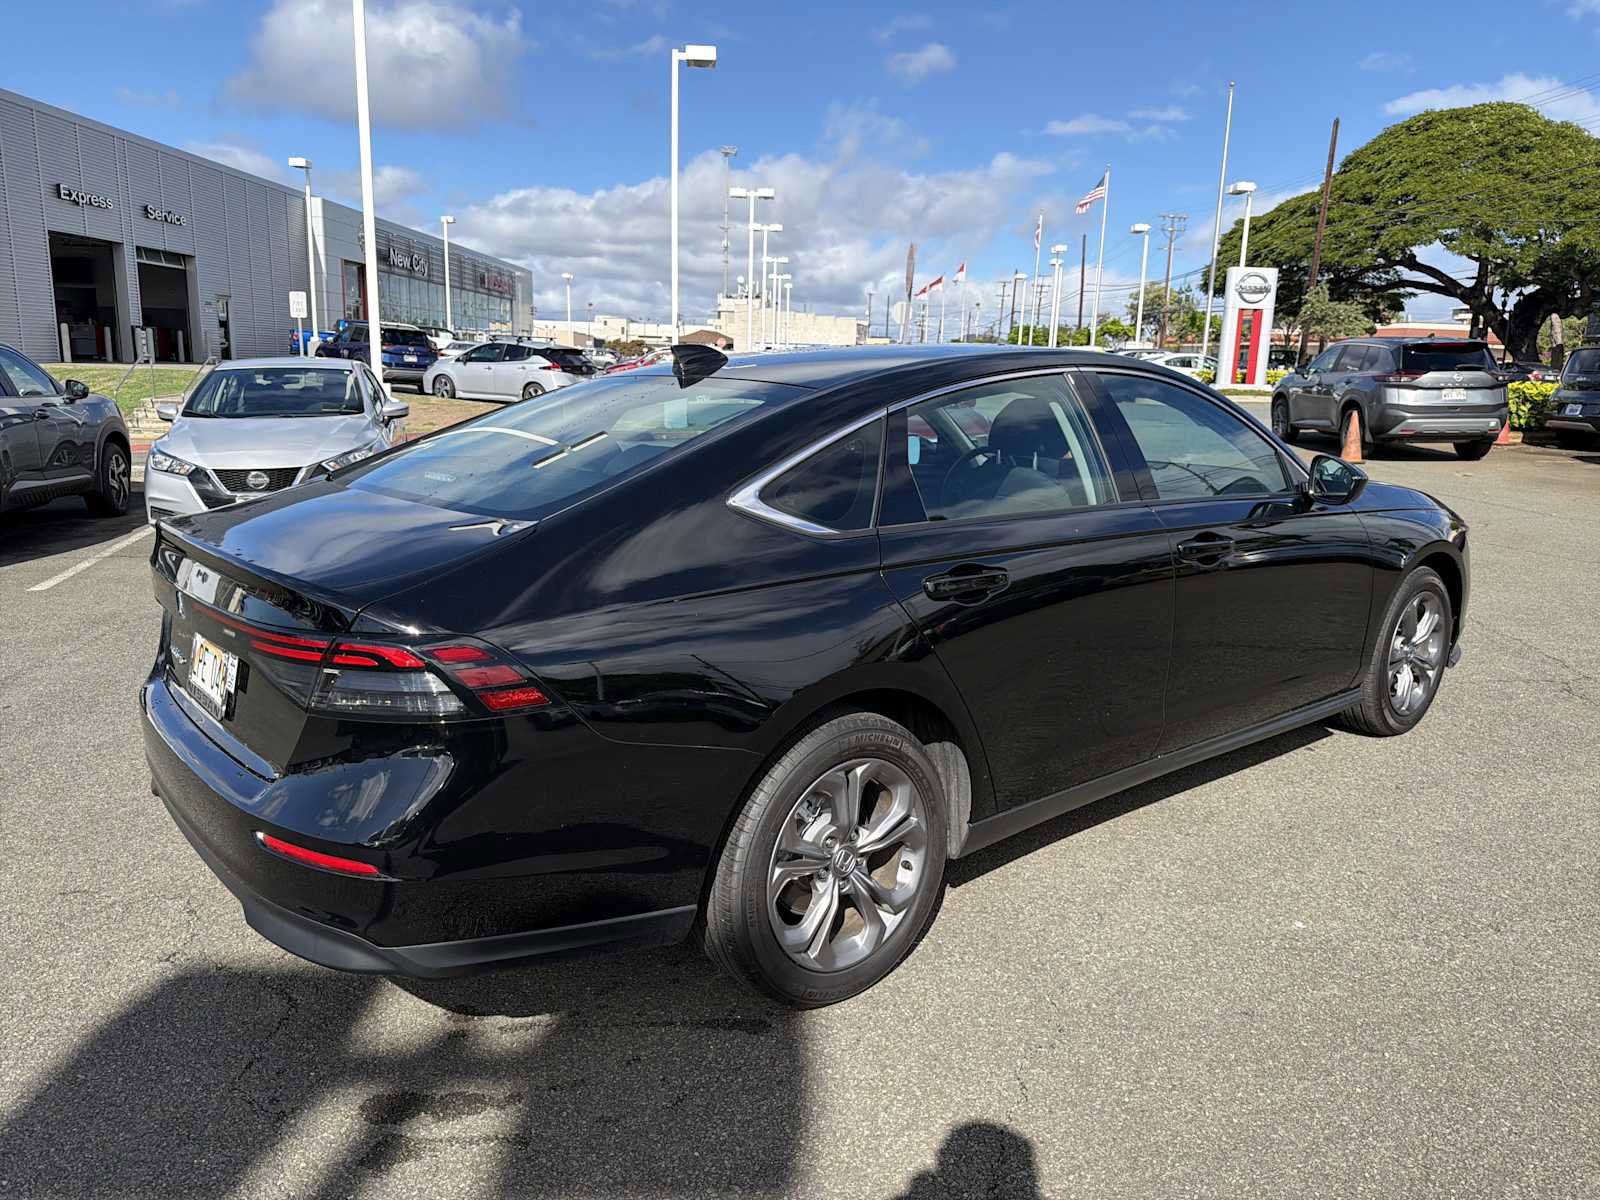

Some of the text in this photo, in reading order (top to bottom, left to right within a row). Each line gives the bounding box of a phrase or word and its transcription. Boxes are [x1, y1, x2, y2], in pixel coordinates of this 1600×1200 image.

[58, 183, 187, 226] Express Service
[389, 247, 429, 277] New City
[855, 732, 902, 749] MICHELIN
